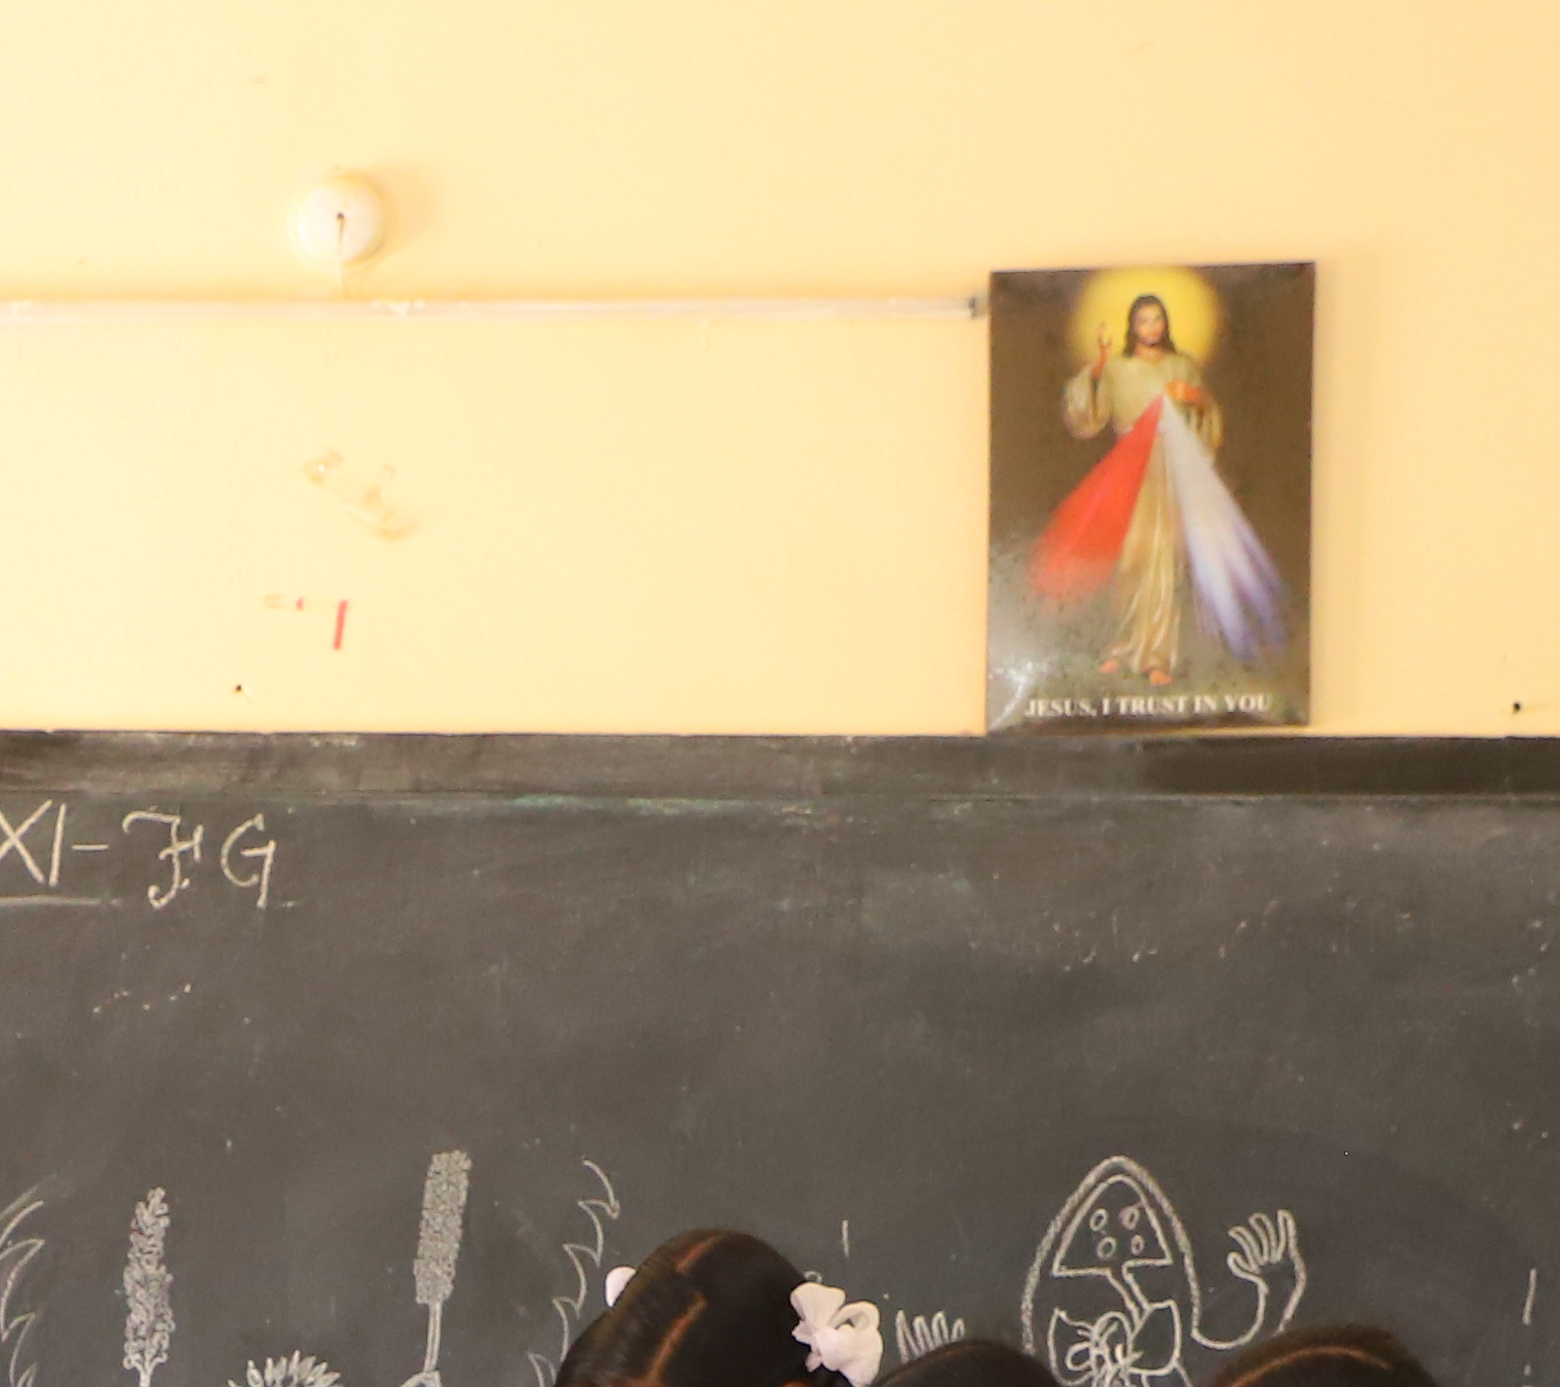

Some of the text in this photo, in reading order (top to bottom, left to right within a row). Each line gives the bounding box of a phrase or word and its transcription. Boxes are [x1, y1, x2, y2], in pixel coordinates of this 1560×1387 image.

[1025, 691, 1273, 718] JESUS, I TRUST IN YOU
[1521, 1267, 1537, 1326] 1
